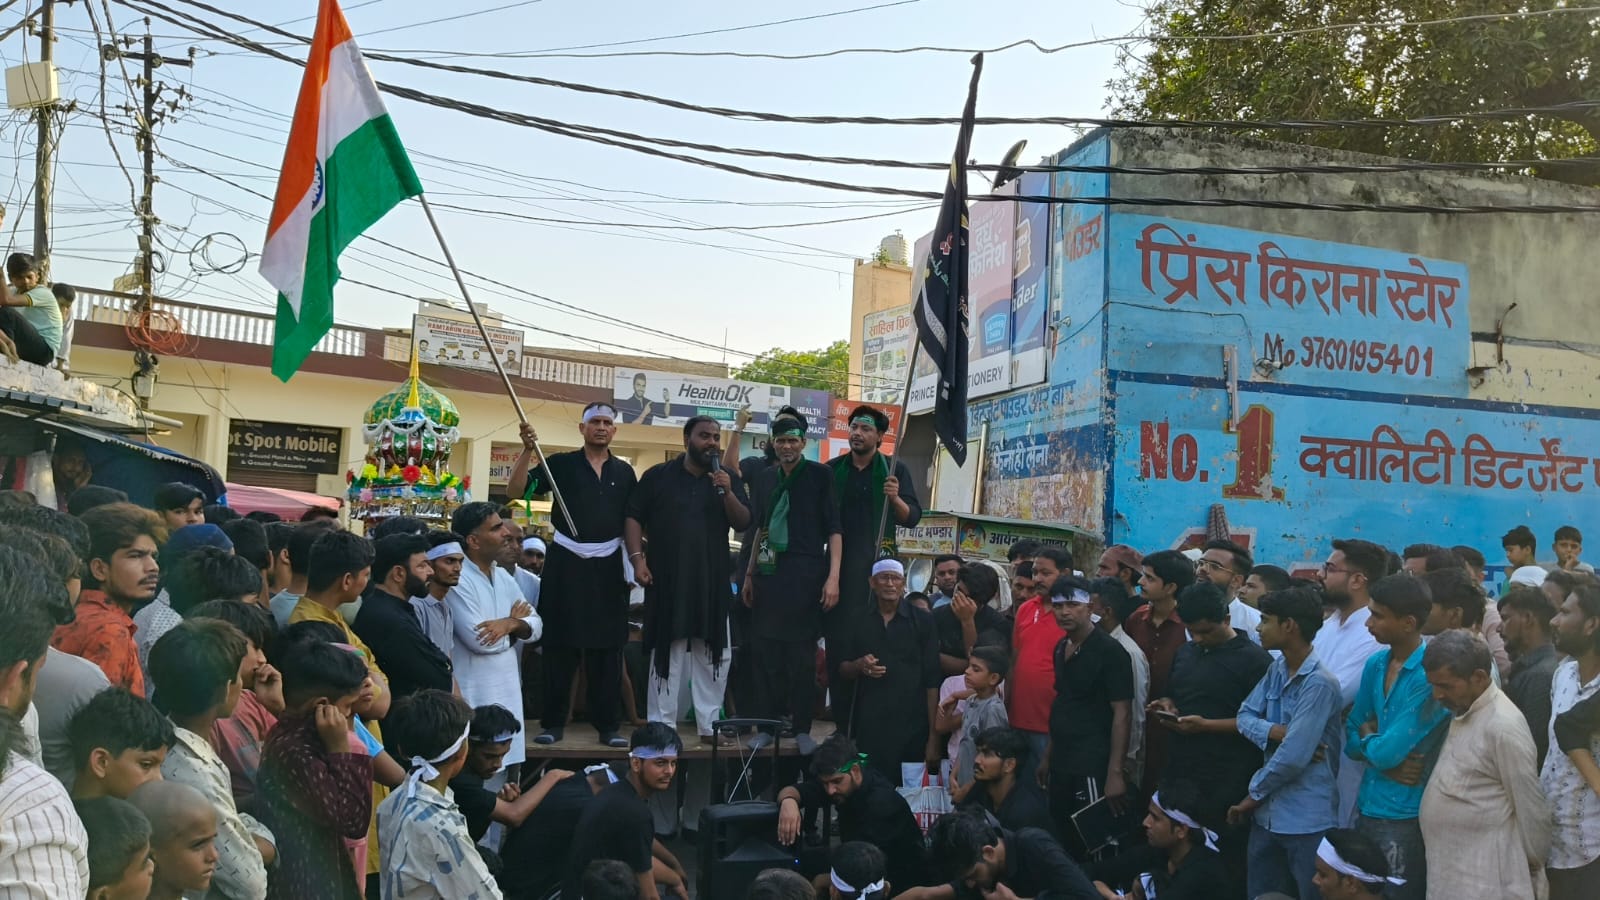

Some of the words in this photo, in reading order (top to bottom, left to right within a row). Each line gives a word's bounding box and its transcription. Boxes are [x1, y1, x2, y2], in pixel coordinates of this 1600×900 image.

[1136, 223, 1251, 305] प्रिंस
[1257, 241, 1380, 317] किराना
[1384, 257, 1461, 328] स्टोर
[493, 332, 521, 342] INSTITUTE
[678, 383, 754, 404] HealthOK
[911, 386, 935, 403] PRINCE
[796, 406, 821, 417] HEALTH
[805, 416, 817, 425] ARE
[244, 432, 282, 451] Spot
[285, 436, 337, 453] Mobile
[1138, 420, 1209, 483] No.
[1222, 403, 1285, 500] 1
[1300, 424, 1455, 487] क्वालिटी
